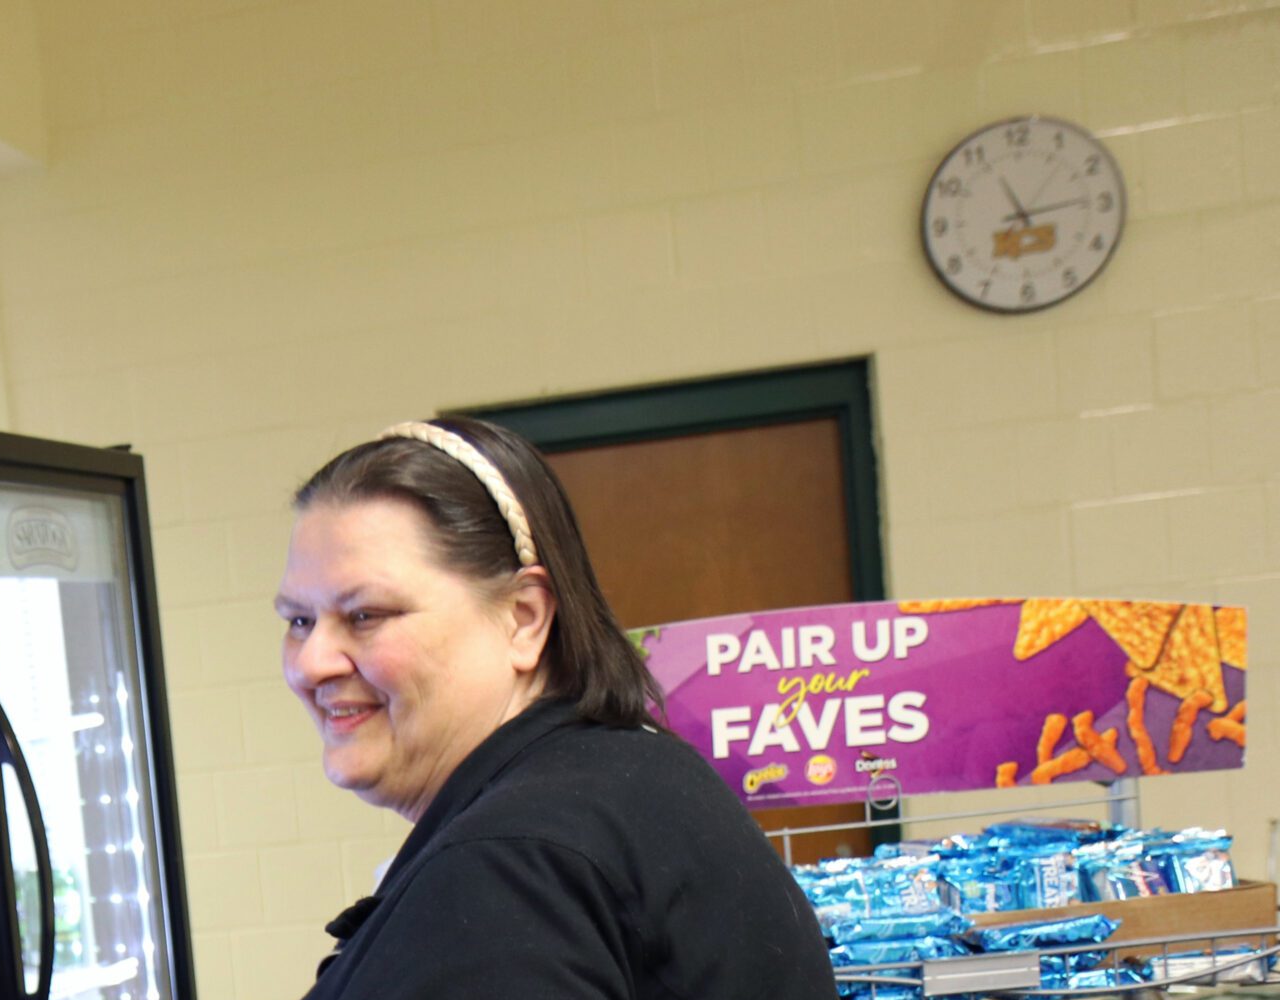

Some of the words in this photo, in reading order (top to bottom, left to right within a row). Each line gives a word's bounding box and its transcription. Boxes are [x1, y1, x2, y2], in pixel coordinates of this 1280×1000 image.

[706, 625, 837, 676] PAIR
[852, 616, 929, 662] UP
[711, 691, 930, 759] FAVES
[777, 668, 871, 728] your
